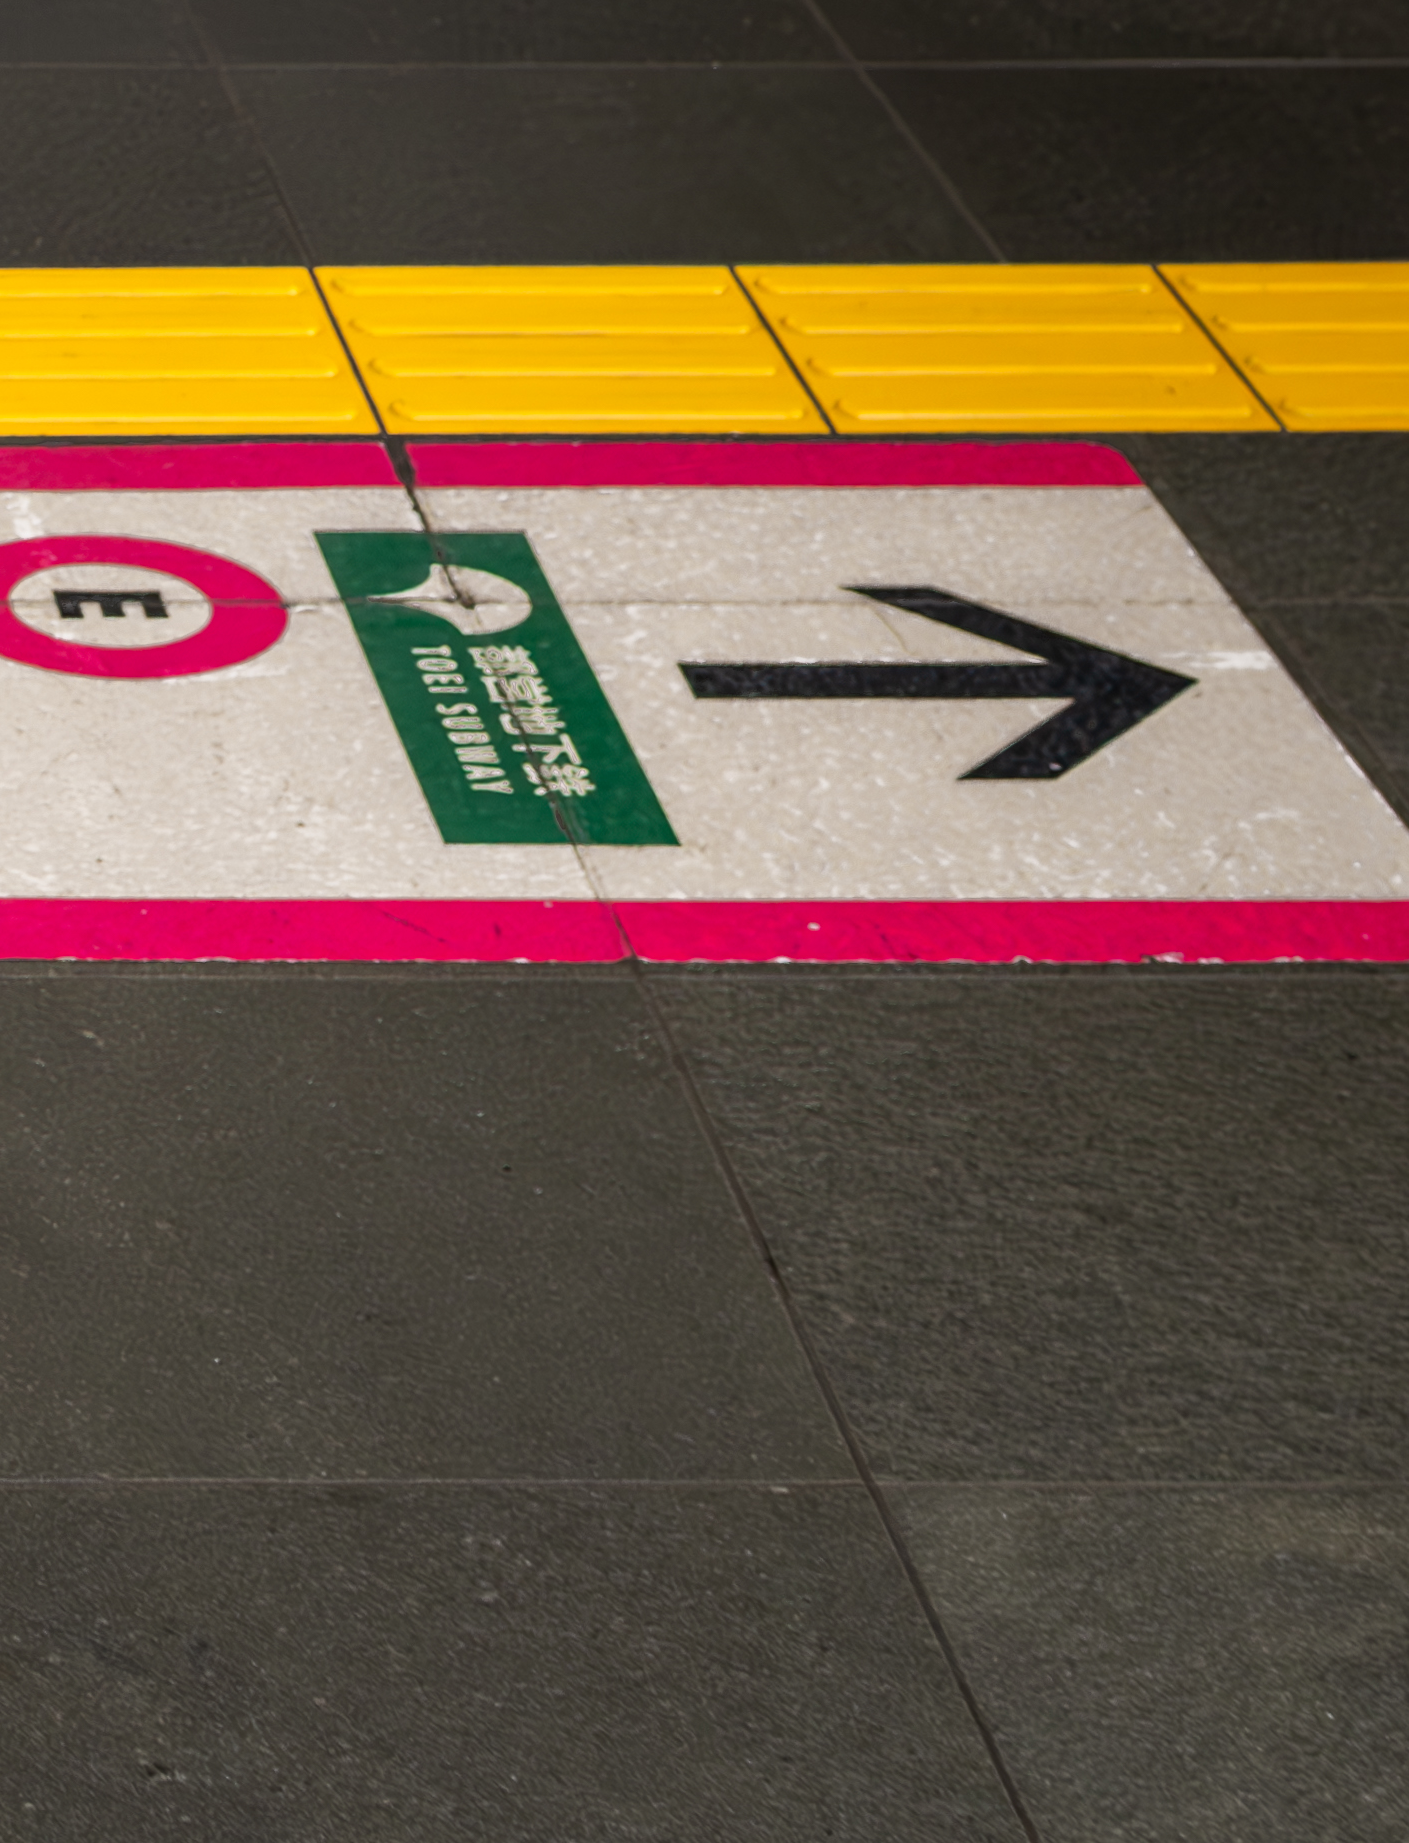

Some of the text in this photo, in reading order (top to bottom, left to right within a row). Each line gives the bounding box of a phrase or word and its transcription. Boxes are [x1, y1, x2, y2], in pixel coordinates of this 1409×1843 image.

[52, 589, 170, 619] E
[411, 645, 514, 795] TOEI SUBWAY
[467, 645, 596, 797] 都営地下鉄
